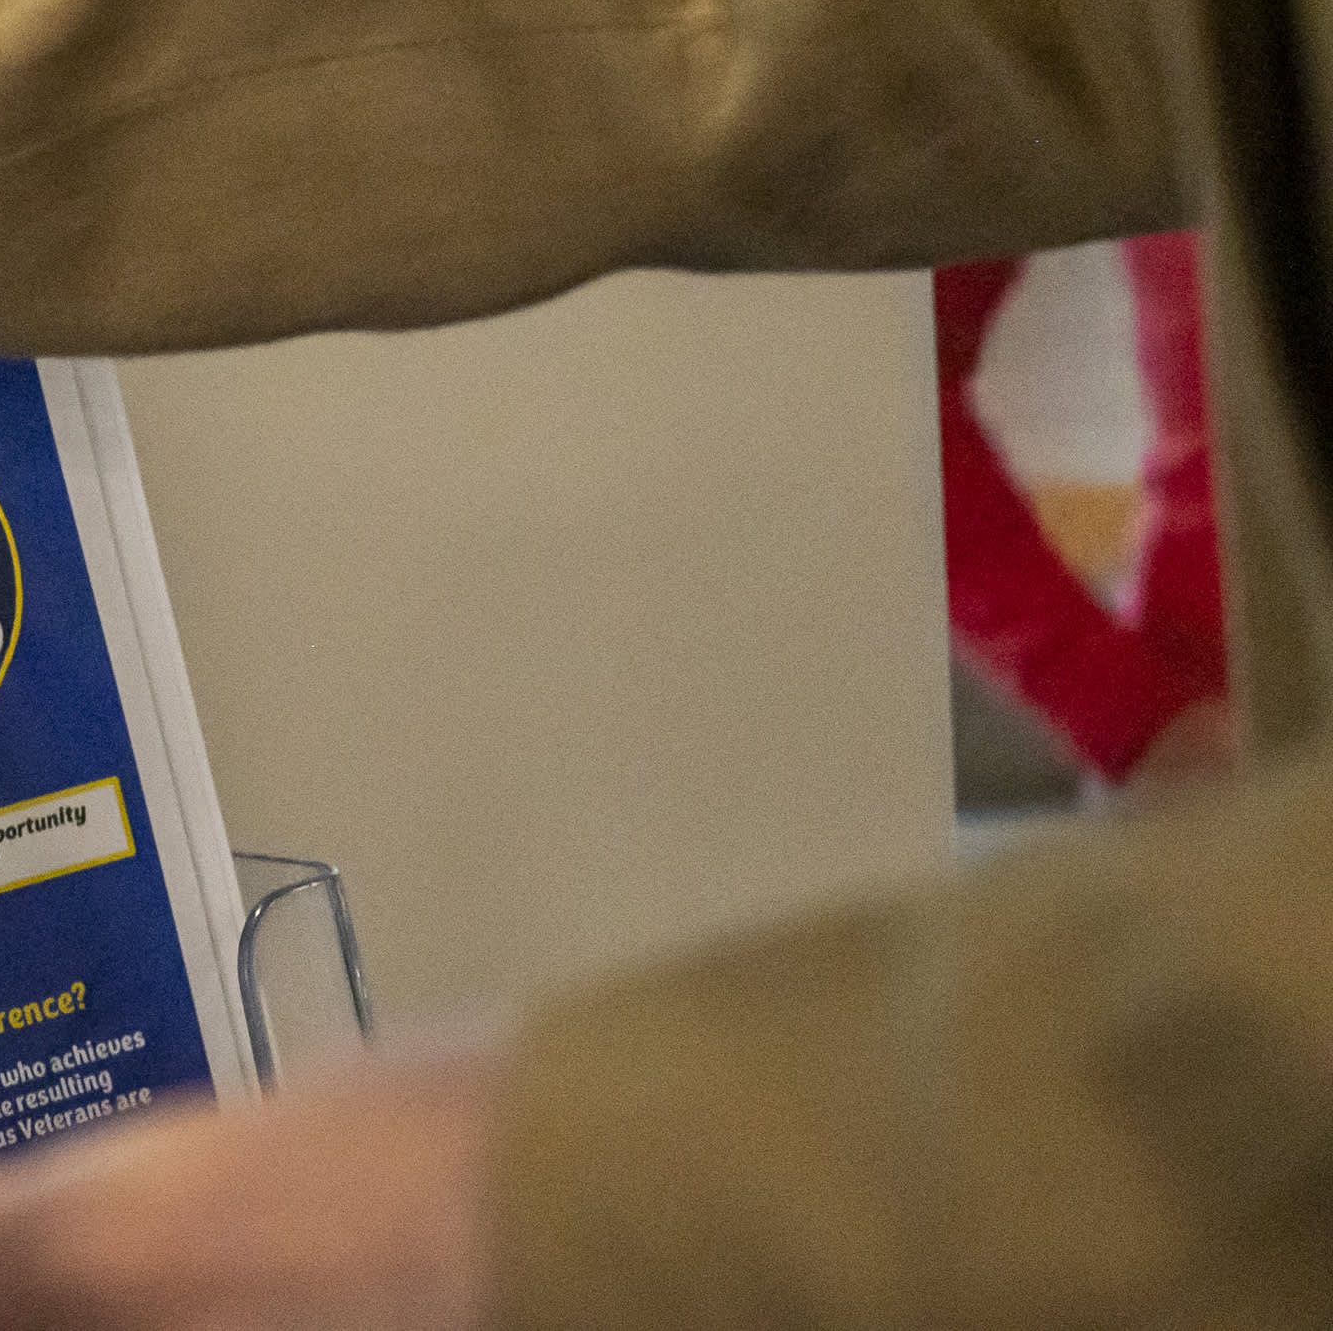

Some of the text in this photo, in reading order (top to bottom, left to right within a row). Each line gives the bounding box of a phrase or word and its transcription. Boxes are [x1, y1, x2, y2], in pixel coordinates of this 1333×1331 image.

[0, 1061, 46, 1089] who
[50, 1030, 146, 1074] achieves
[15, 1069, 114, 1114] resulting
[18, 1096, 113, 1140] Veterans
[116, 1085, 153, 1110] are
